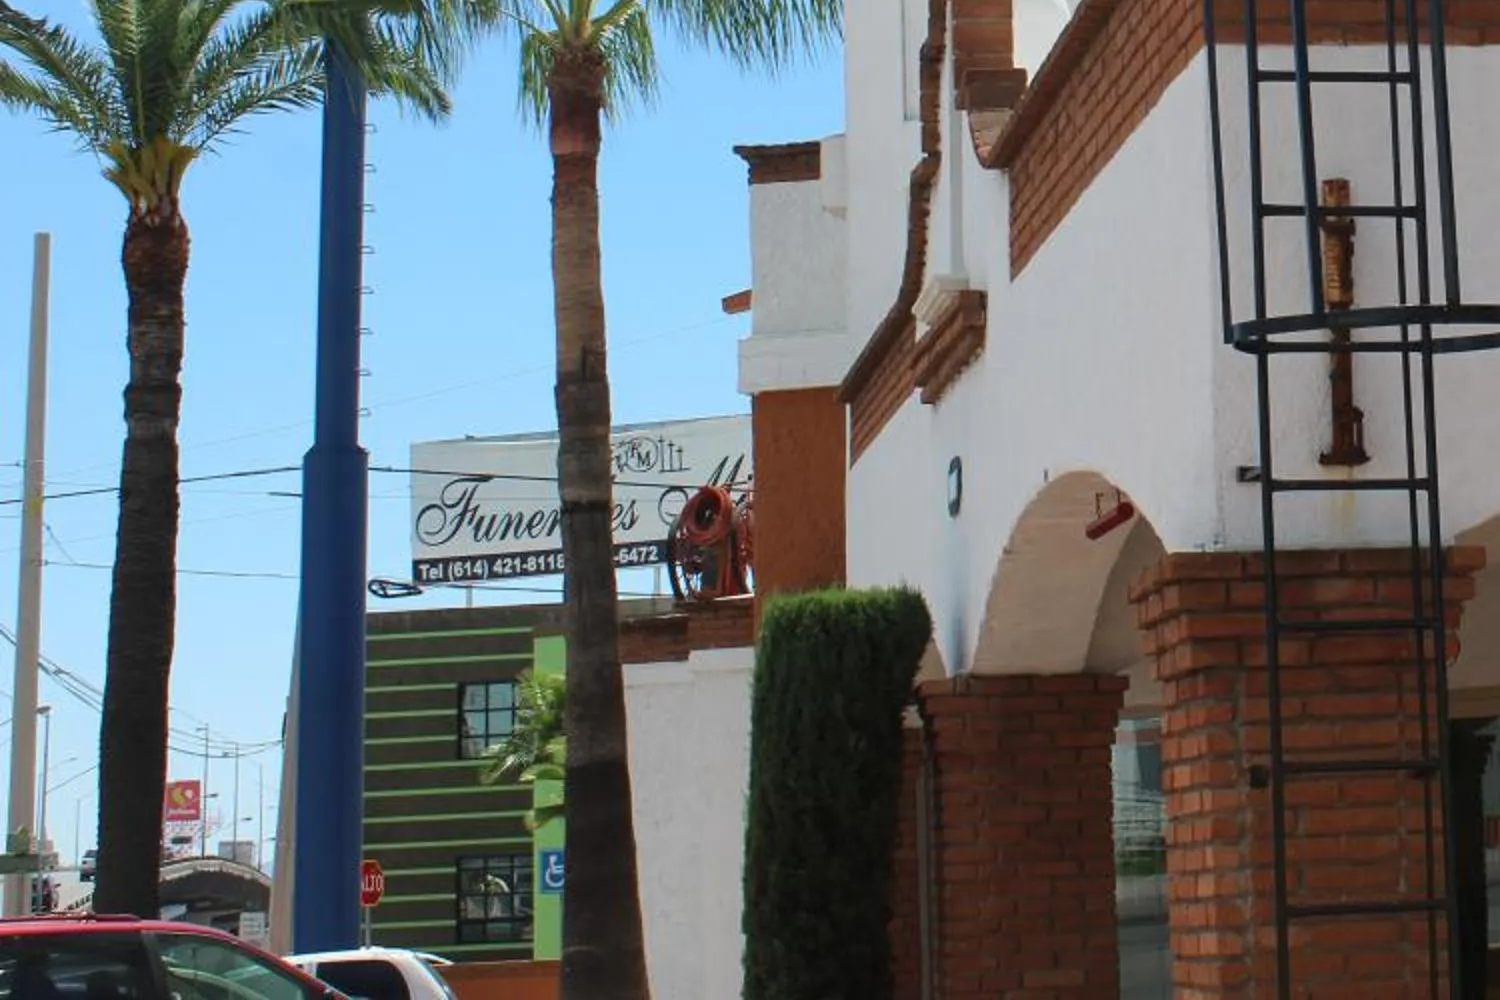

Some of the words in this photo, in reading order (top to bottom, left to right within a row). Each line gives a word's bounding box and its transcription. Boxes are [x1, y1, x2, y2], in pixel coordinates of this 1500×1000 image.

[416, 475, 639, 546] Funeres
[419, 564, 443, 580] Tel
[448, 561, 489, 581] (614)
